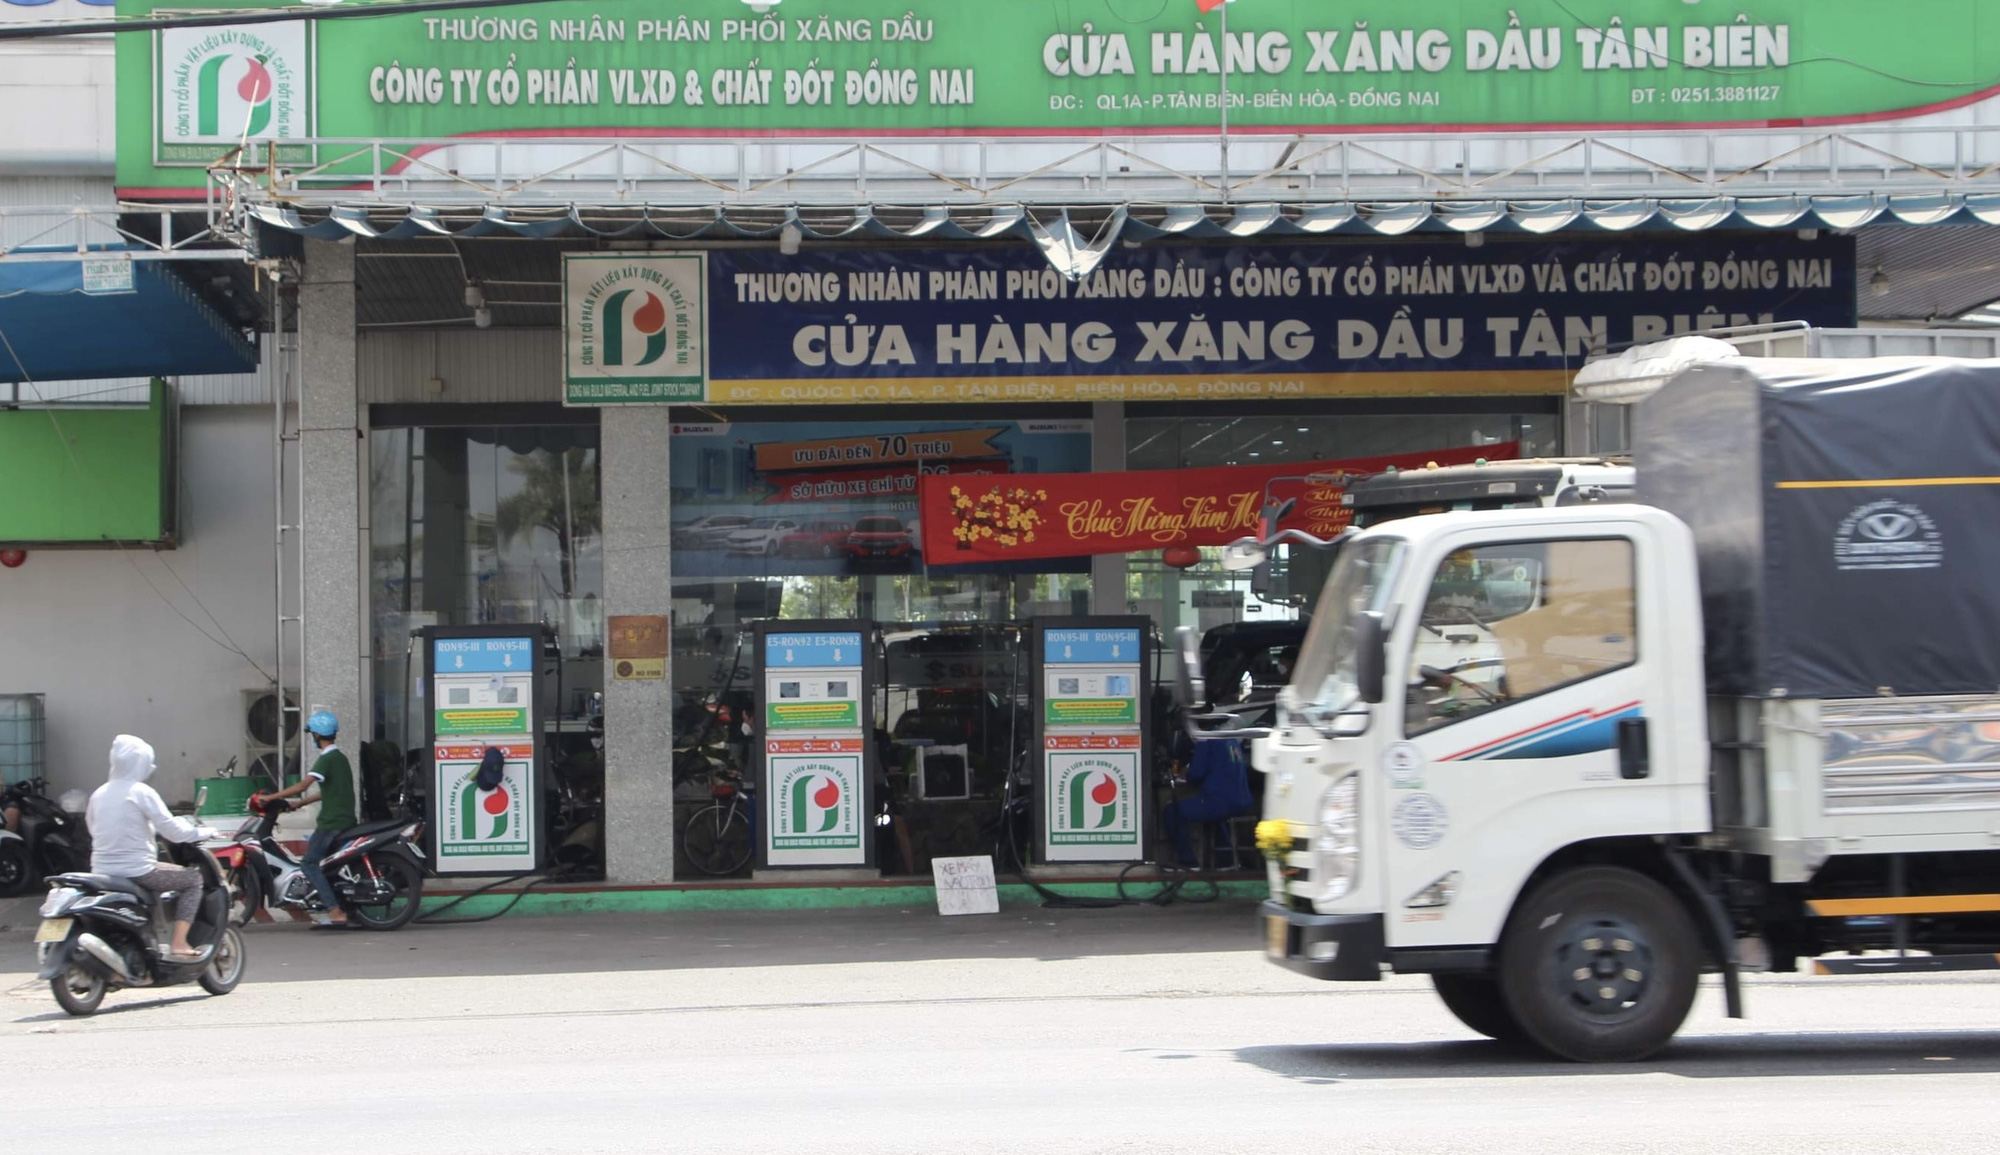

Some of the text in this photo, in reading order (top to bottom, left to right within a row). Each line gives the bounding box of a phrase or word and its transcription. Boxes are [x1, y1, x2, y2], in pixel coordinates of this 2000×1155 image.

[424, 10, 933, 41] THƯƠNG NHÂN PHÂN PHỐI XĂNG DẦU
[1043, 10, 1789, 77] CỬA HÀNG XĂNG DẦU TÂN BIÊN
[370, 52, 974, 105] CÔNG TY CỔ PHẦN VLXD & CHẤT ĐỐT ĐỒNG NAI
[1408, 92, 1440, 106] NAI
[1671, 86, 1780, 103] 0251.3881127
[178, 102, 190, 112] TY
[601, 268, 620, 286] LIỆU
[622, 265, 638, 278] XÂY
[641, 267, 663, 284] DỰNG
[734, 272, 840, 302] THƯƠNG
[849, 266, 920, 300] NHÂN
[929, 266, 997, 300] PHÂN
[1074, 265, 1146, 298] XĂNG
[1154, 258, 1205, 297] DẦU
[1230, 262, 1300, 297] CÔNG
[1308, 267, 1337, 296] TY
[1344, 256, 1376, 296] CỔ
[1385, 256, 1454, 294] PHẦN
[1461, 264, 1526, 294] VLXD
[1532, 258, 1567, 294] VÀ
[1574, 254, 1636, 292] CHẤT
[1644, 252, 1694, 291] ĐỐT
[1702, 251, 1778, 290] ĐỒNG
[1788, 259, 1832, 288] NAI
[589, 282, 605, 298] VẬT
[583, 334, 594, 343] TY
[792, 314, 916, 366] CỬA
[936, 315, 1116, 364] HÀNG
[1134, 313, 1314, 362] XĂNG
[1338, 306, 1464, 360] DẦU
[1487, 308, 1608, 356] TÂN
[580, 345, 594, 365] CÔNG
[677, 352, 688, 364] NAI
[889, 386, 913, 397] 1A
[956, 384, 998, 396] TÂN
[1005, 382, 1055, 395] BIÊN
[1076, 382, 1125, 395] BIÊN
[1132, 381, 1179, 394] HÒA
[1269, 380, 1304, 392] NAI
[794, 451, 814, 462] ƯU
[819, 448, 841, 461] ĐÃI
[877, 436, 907, 457] 70
[913, 442, 951, 455] TRIỆU
[850, 481, 866, 494] XE
[1060, 499, 1124, 540] Chúc
[1121, 497, 1188, 542] Mừng
[1182, 496, 1228, 532] Năm
[768, 636, 859, 647] E5-RON92 E5-RON92
[1048, 632, 1136, 642] RON95-III RON95-III
[438, 641, 528, 652] RON95-III RON95-III
